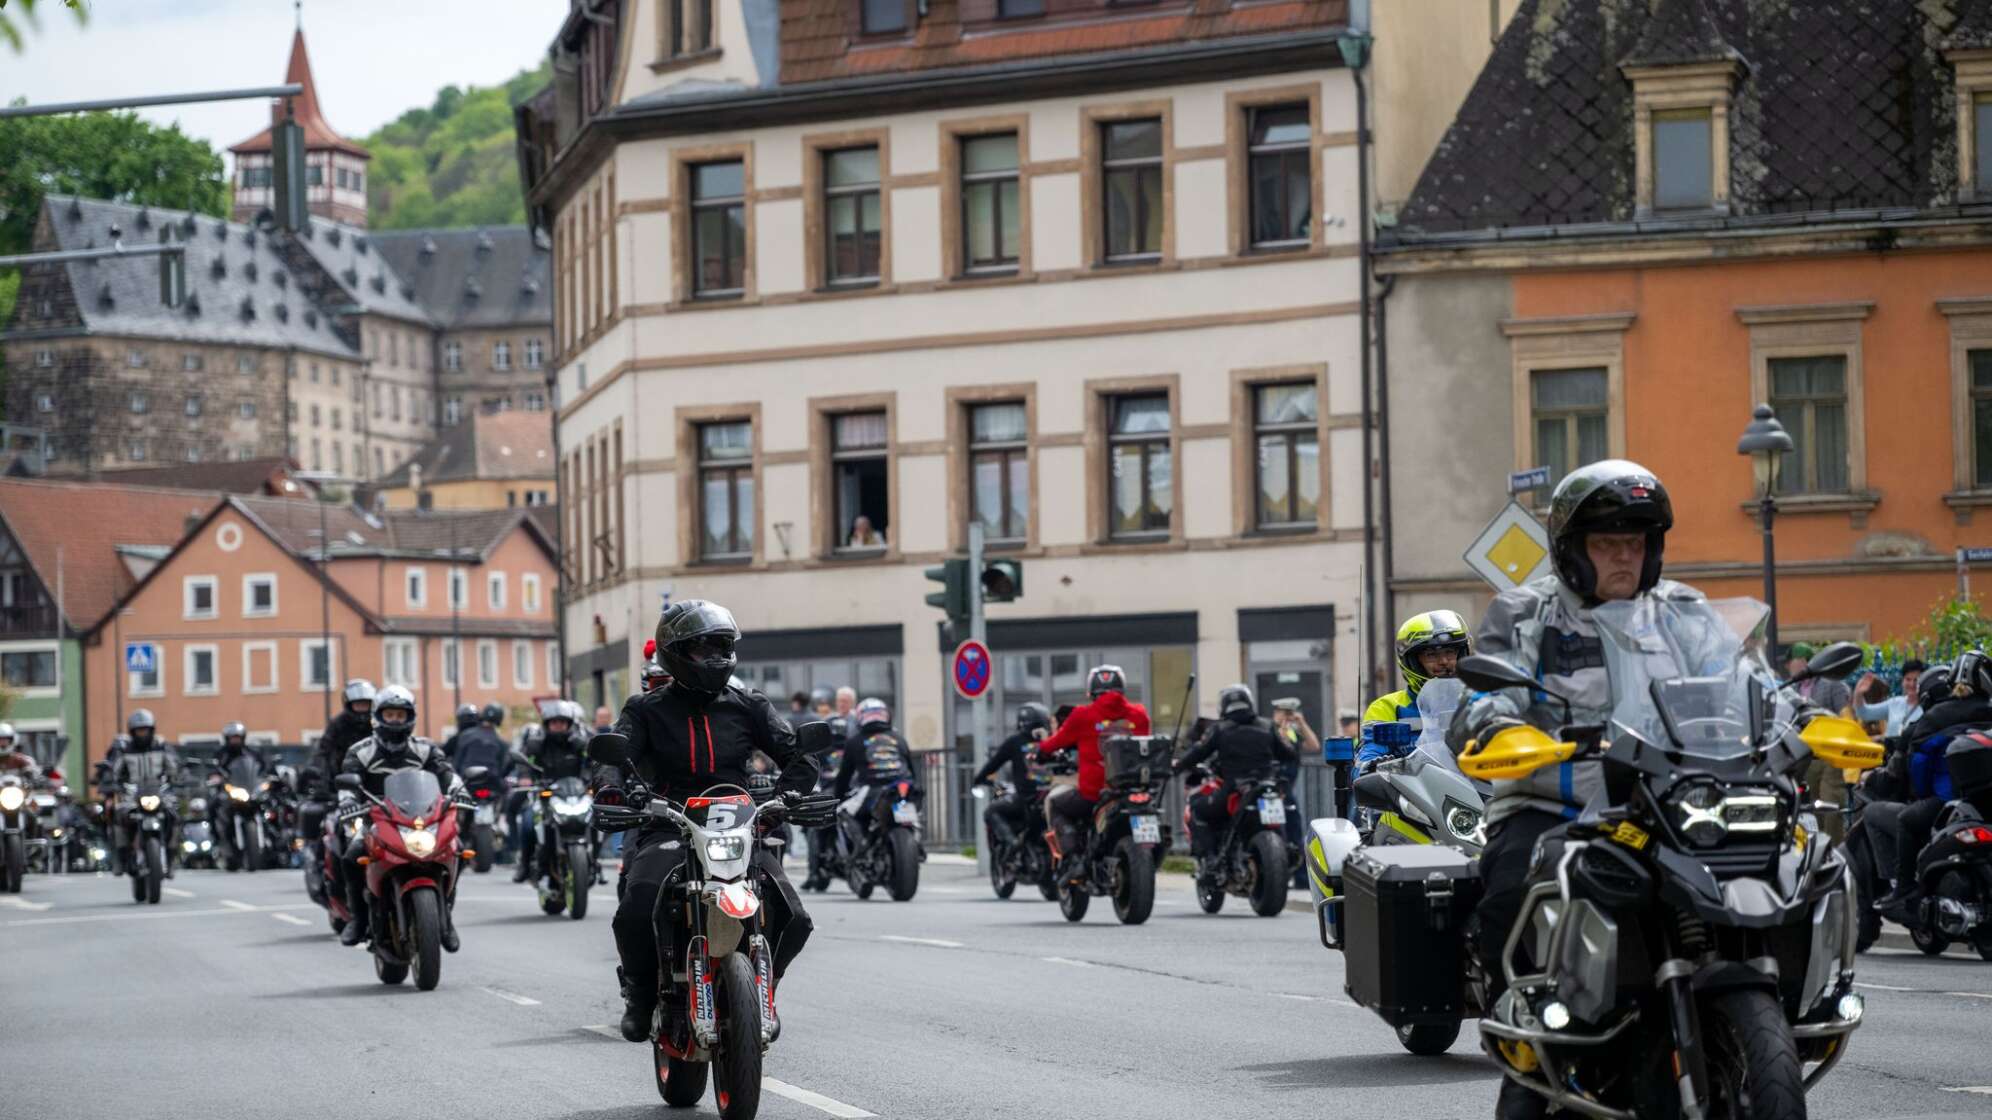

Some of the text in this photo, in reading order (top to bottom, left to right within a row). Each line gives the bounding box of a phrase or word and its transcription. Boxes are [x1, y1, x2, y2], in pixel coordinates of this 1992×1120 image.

[706, 803, 738, 831] 5
[694, 960, 705, 1019] MICHELIN
[760, 959, 770, 1018] MICHELIN
